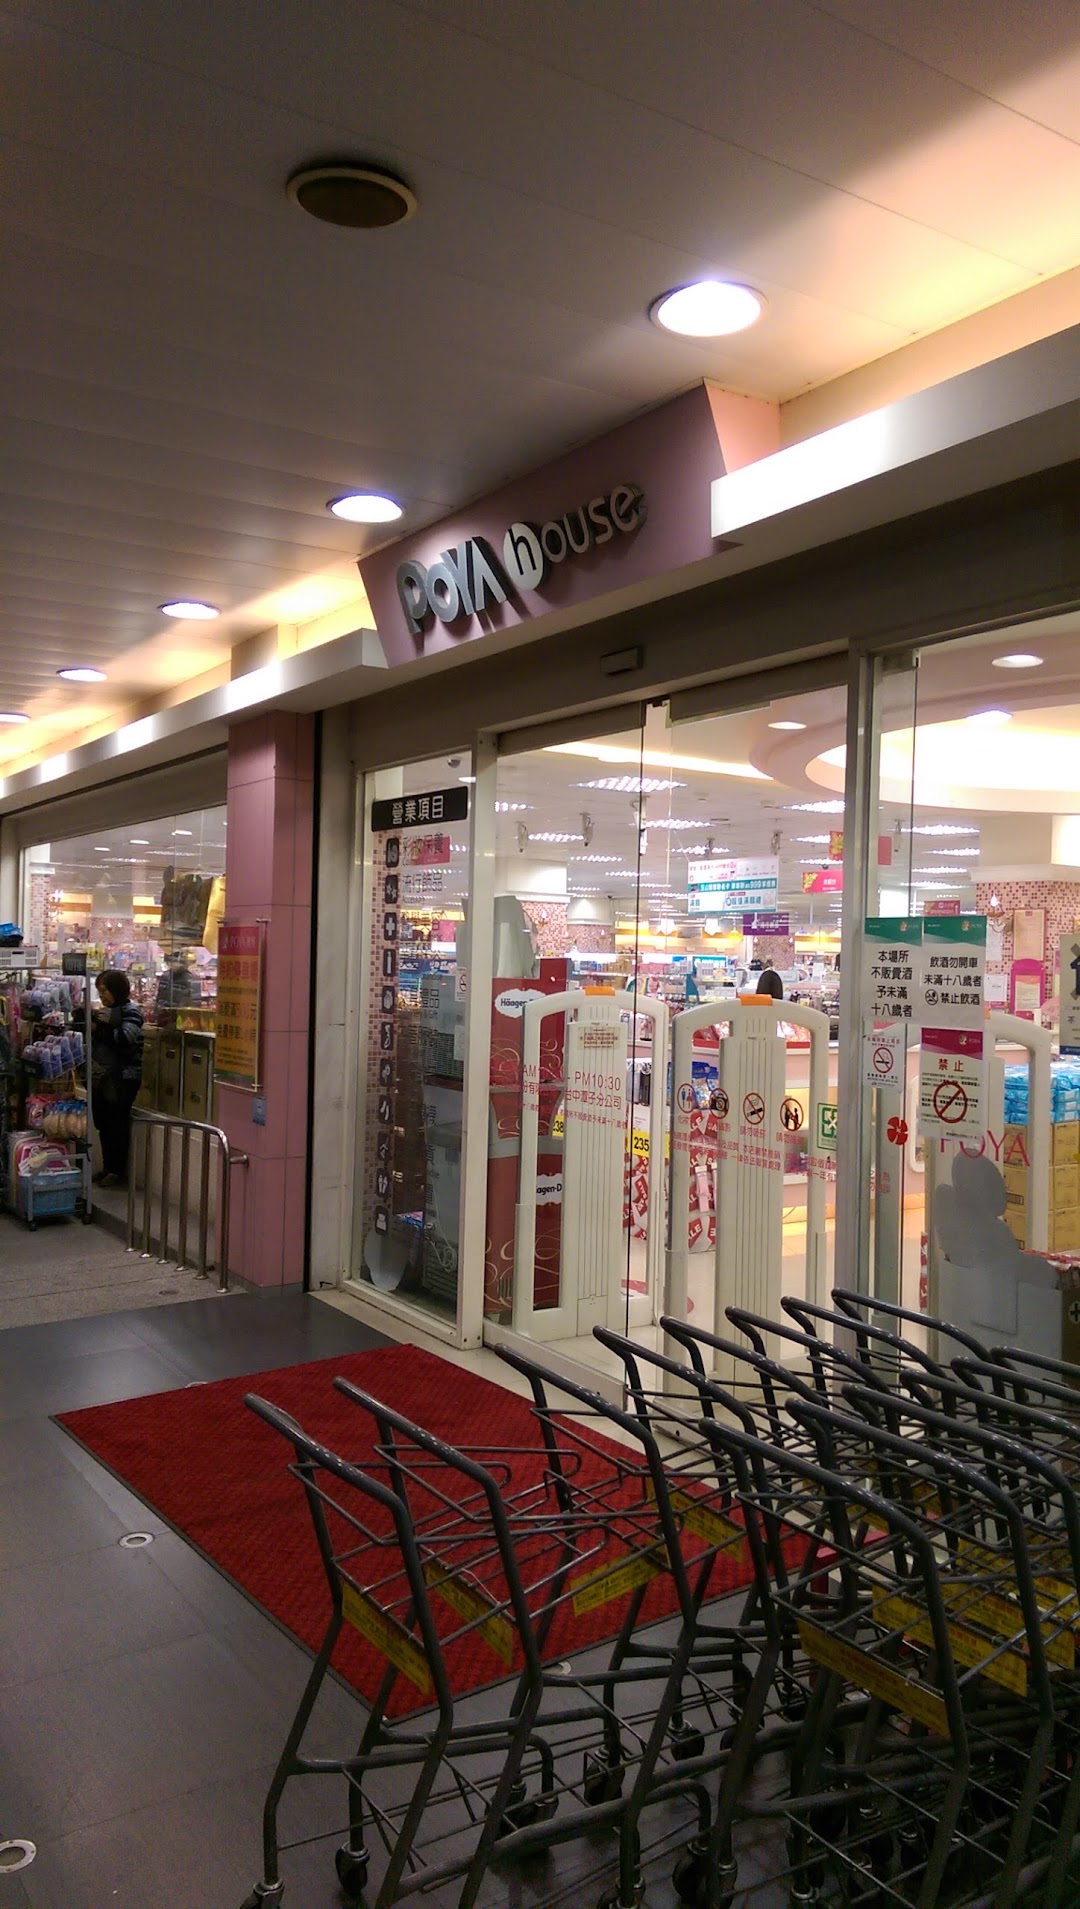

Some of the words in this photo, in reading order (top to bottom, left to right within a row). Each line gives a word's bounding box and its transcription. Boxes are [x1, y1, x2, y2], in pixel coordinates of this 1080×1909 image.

[392, 795, 443, 825] 營業項目
[878, 950, 909, 963] 本場所
[930, 956, 978, 969] 飲酒勿開車
[924, 974, 982, 987] 未滿十八歲者
[876, 985, 907, 1000] 予未滿
[940, 992, 980, 1006] 禁止飲酒
[871, 1002, 913, 1018] 十八歲者
[938, 1058, 964, 1072] 禁止
[574, 1071, 621, 1091] PM10:30
[633, 1136, 650, 1151] 235
